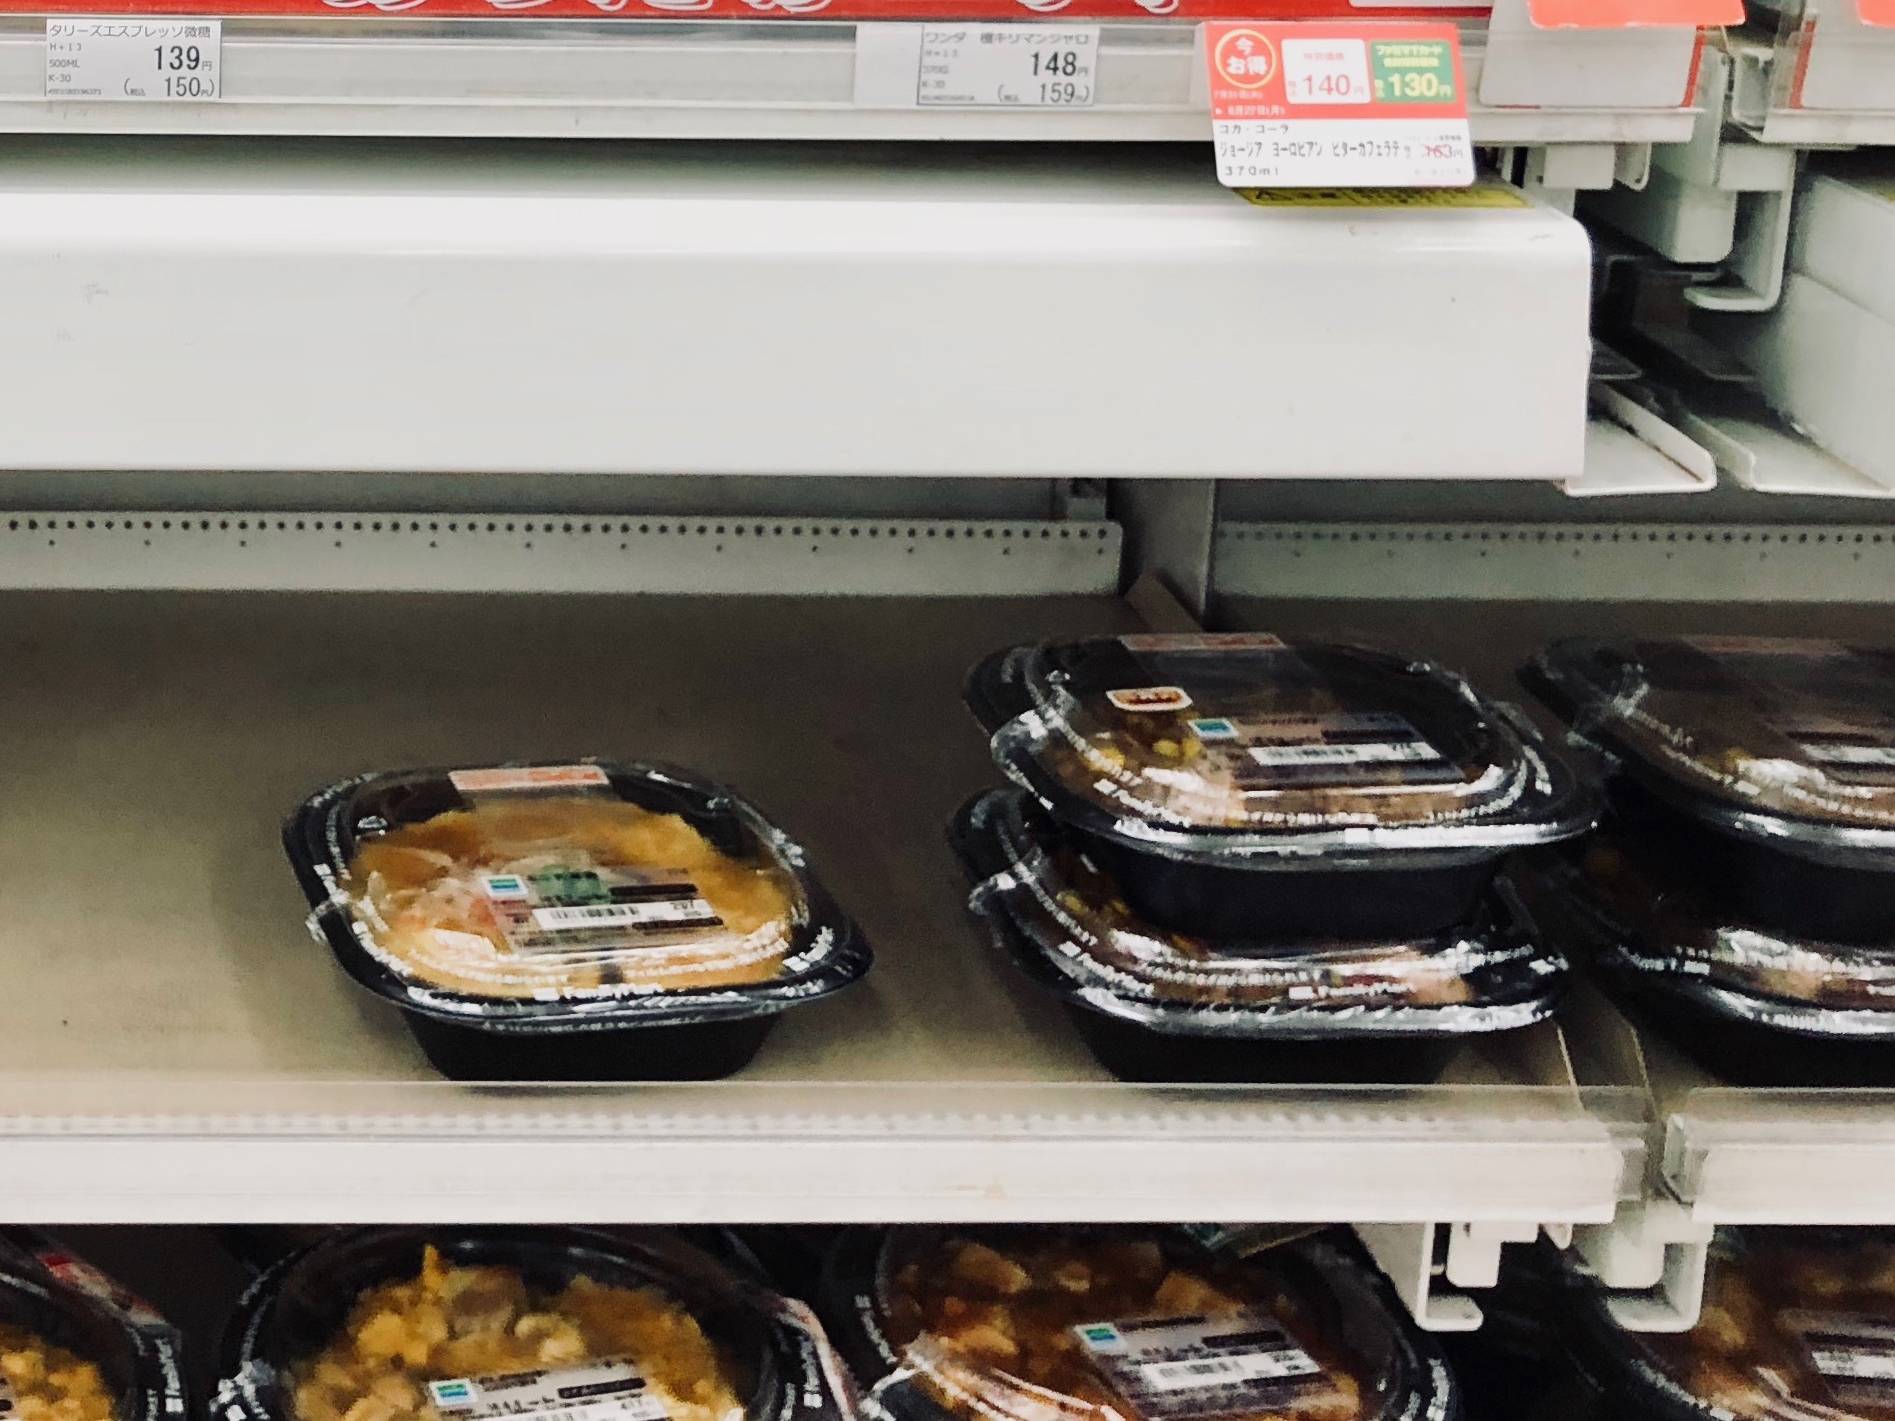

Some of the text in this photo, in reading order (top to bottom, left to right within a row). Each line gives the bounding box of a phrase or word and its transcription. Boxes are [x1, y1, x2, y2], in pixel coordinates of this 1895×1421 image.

[49, 24, 212, 39] タリーズエスプレッソ微糖
[1235, 36, 1255, 56] 今
[48, 58, 81, 69] 500ML
[154, 44, 213, 72] 139円
[1226, 55, 1268, 77] お得
[1219, 124, 1289, 135] コカ・コーラ
